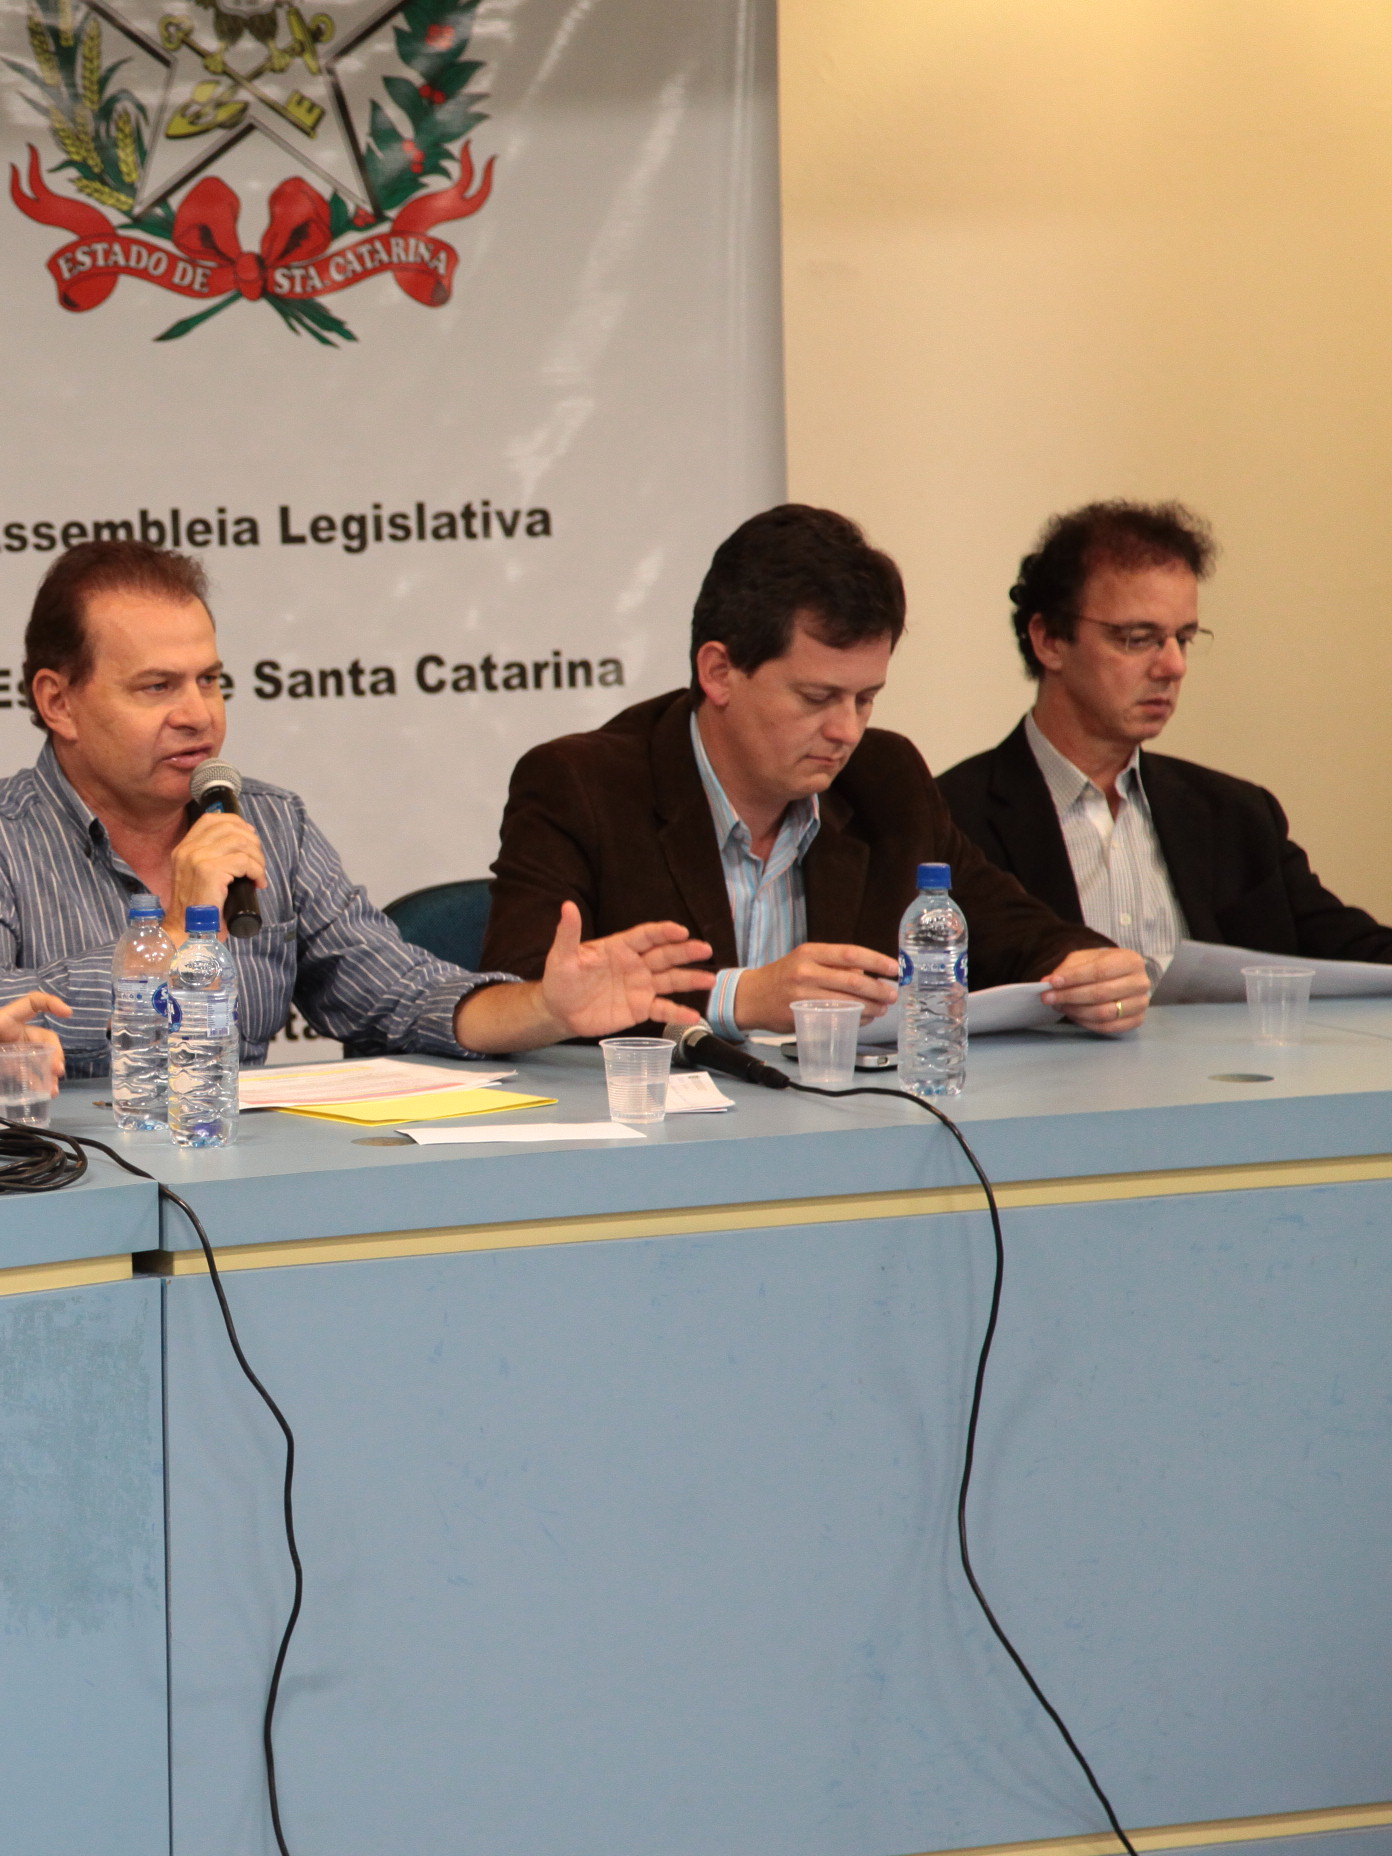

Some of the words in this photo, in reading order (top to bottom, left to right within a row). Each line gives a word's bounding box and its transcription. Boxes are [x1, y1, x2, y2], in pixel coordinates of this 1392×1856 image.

[58, 241, 169, 280] ESTADO
[172, 266, 211, 293] DE
[278, 500, 553, 553] Legislativa
[254, 659, 397, 700] Santa
[415, 651, 625, 694] Catarina
